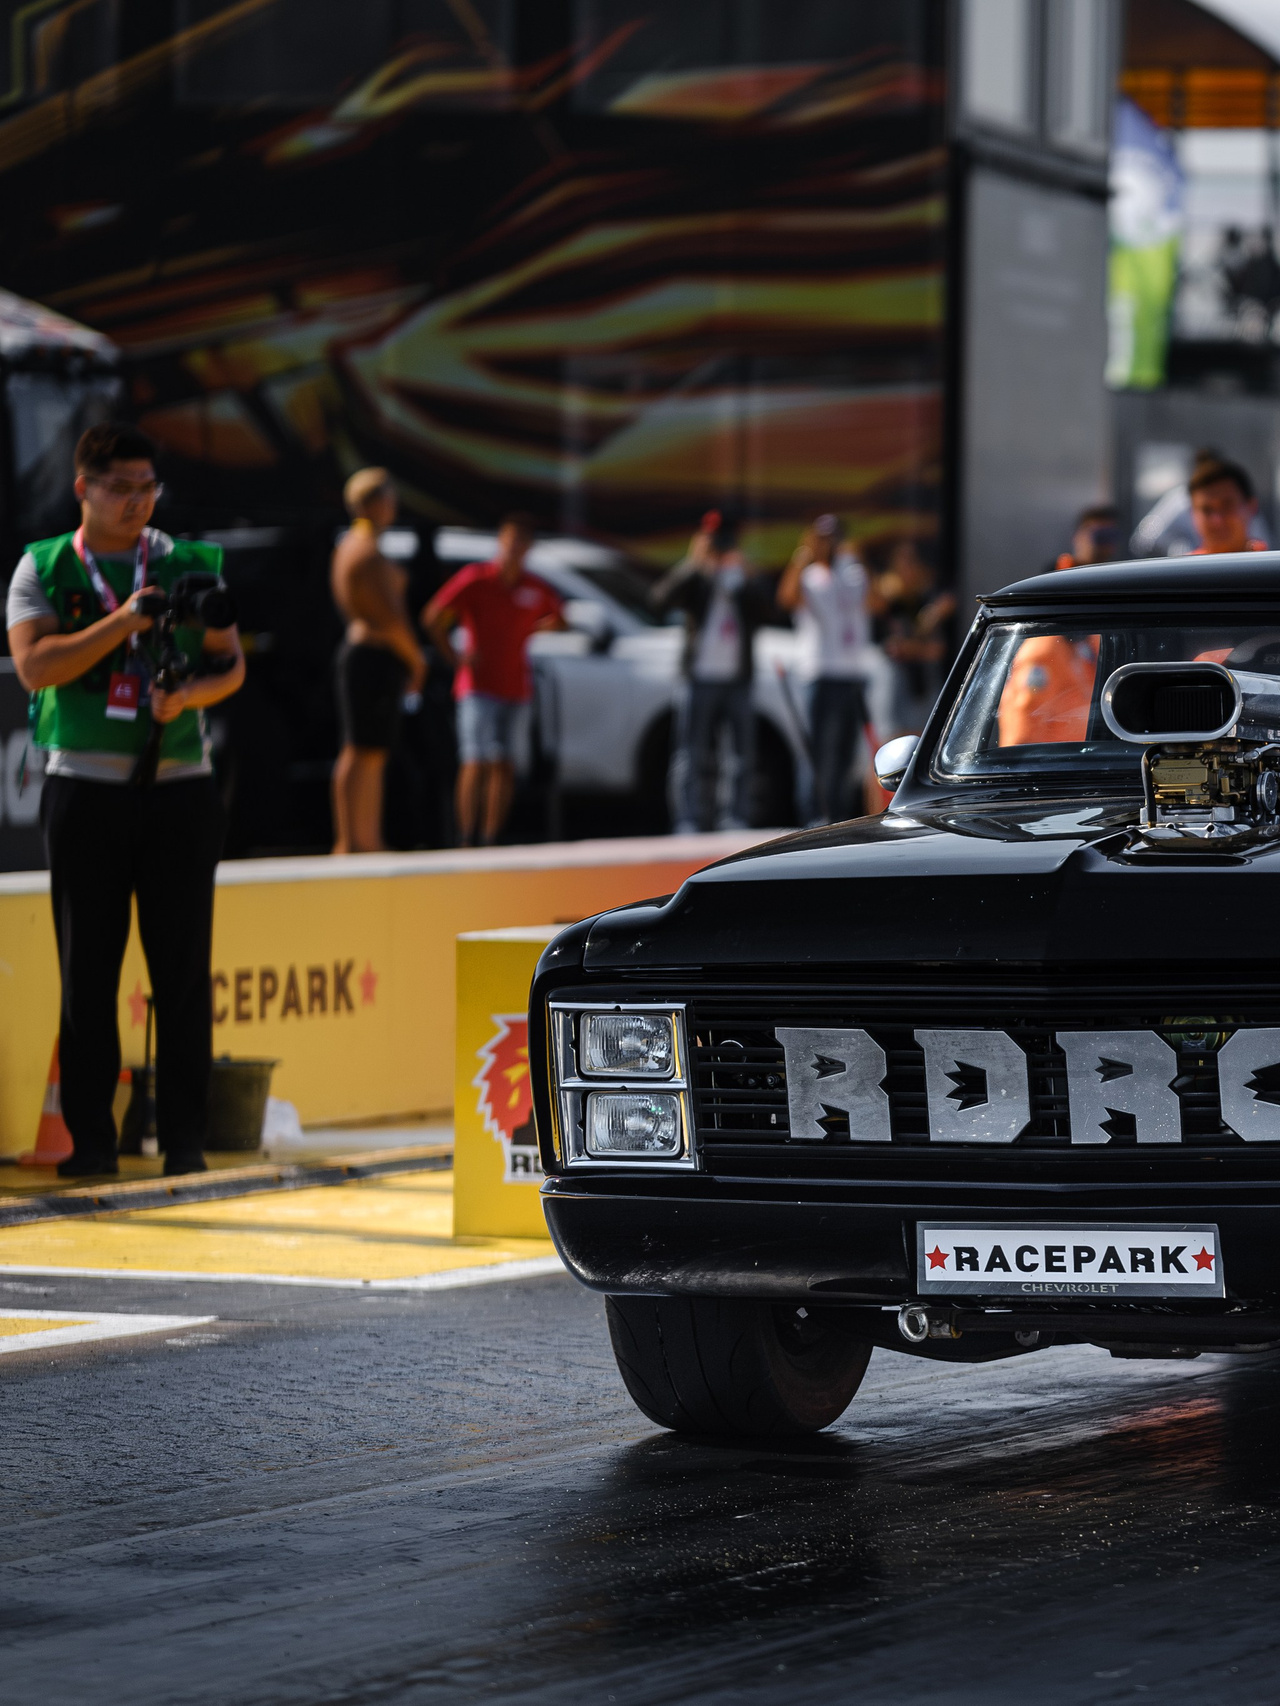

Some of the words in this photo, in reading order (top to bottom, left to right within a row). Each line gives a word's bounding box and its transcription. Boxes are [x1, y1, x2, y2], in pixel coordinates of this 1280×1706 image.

[211, 957, 355, 1028] CEPARK
[952, 1244, 1190, 1274] RACEPARK
[1021, 1283, 1119, 1294] CHEVROLET
